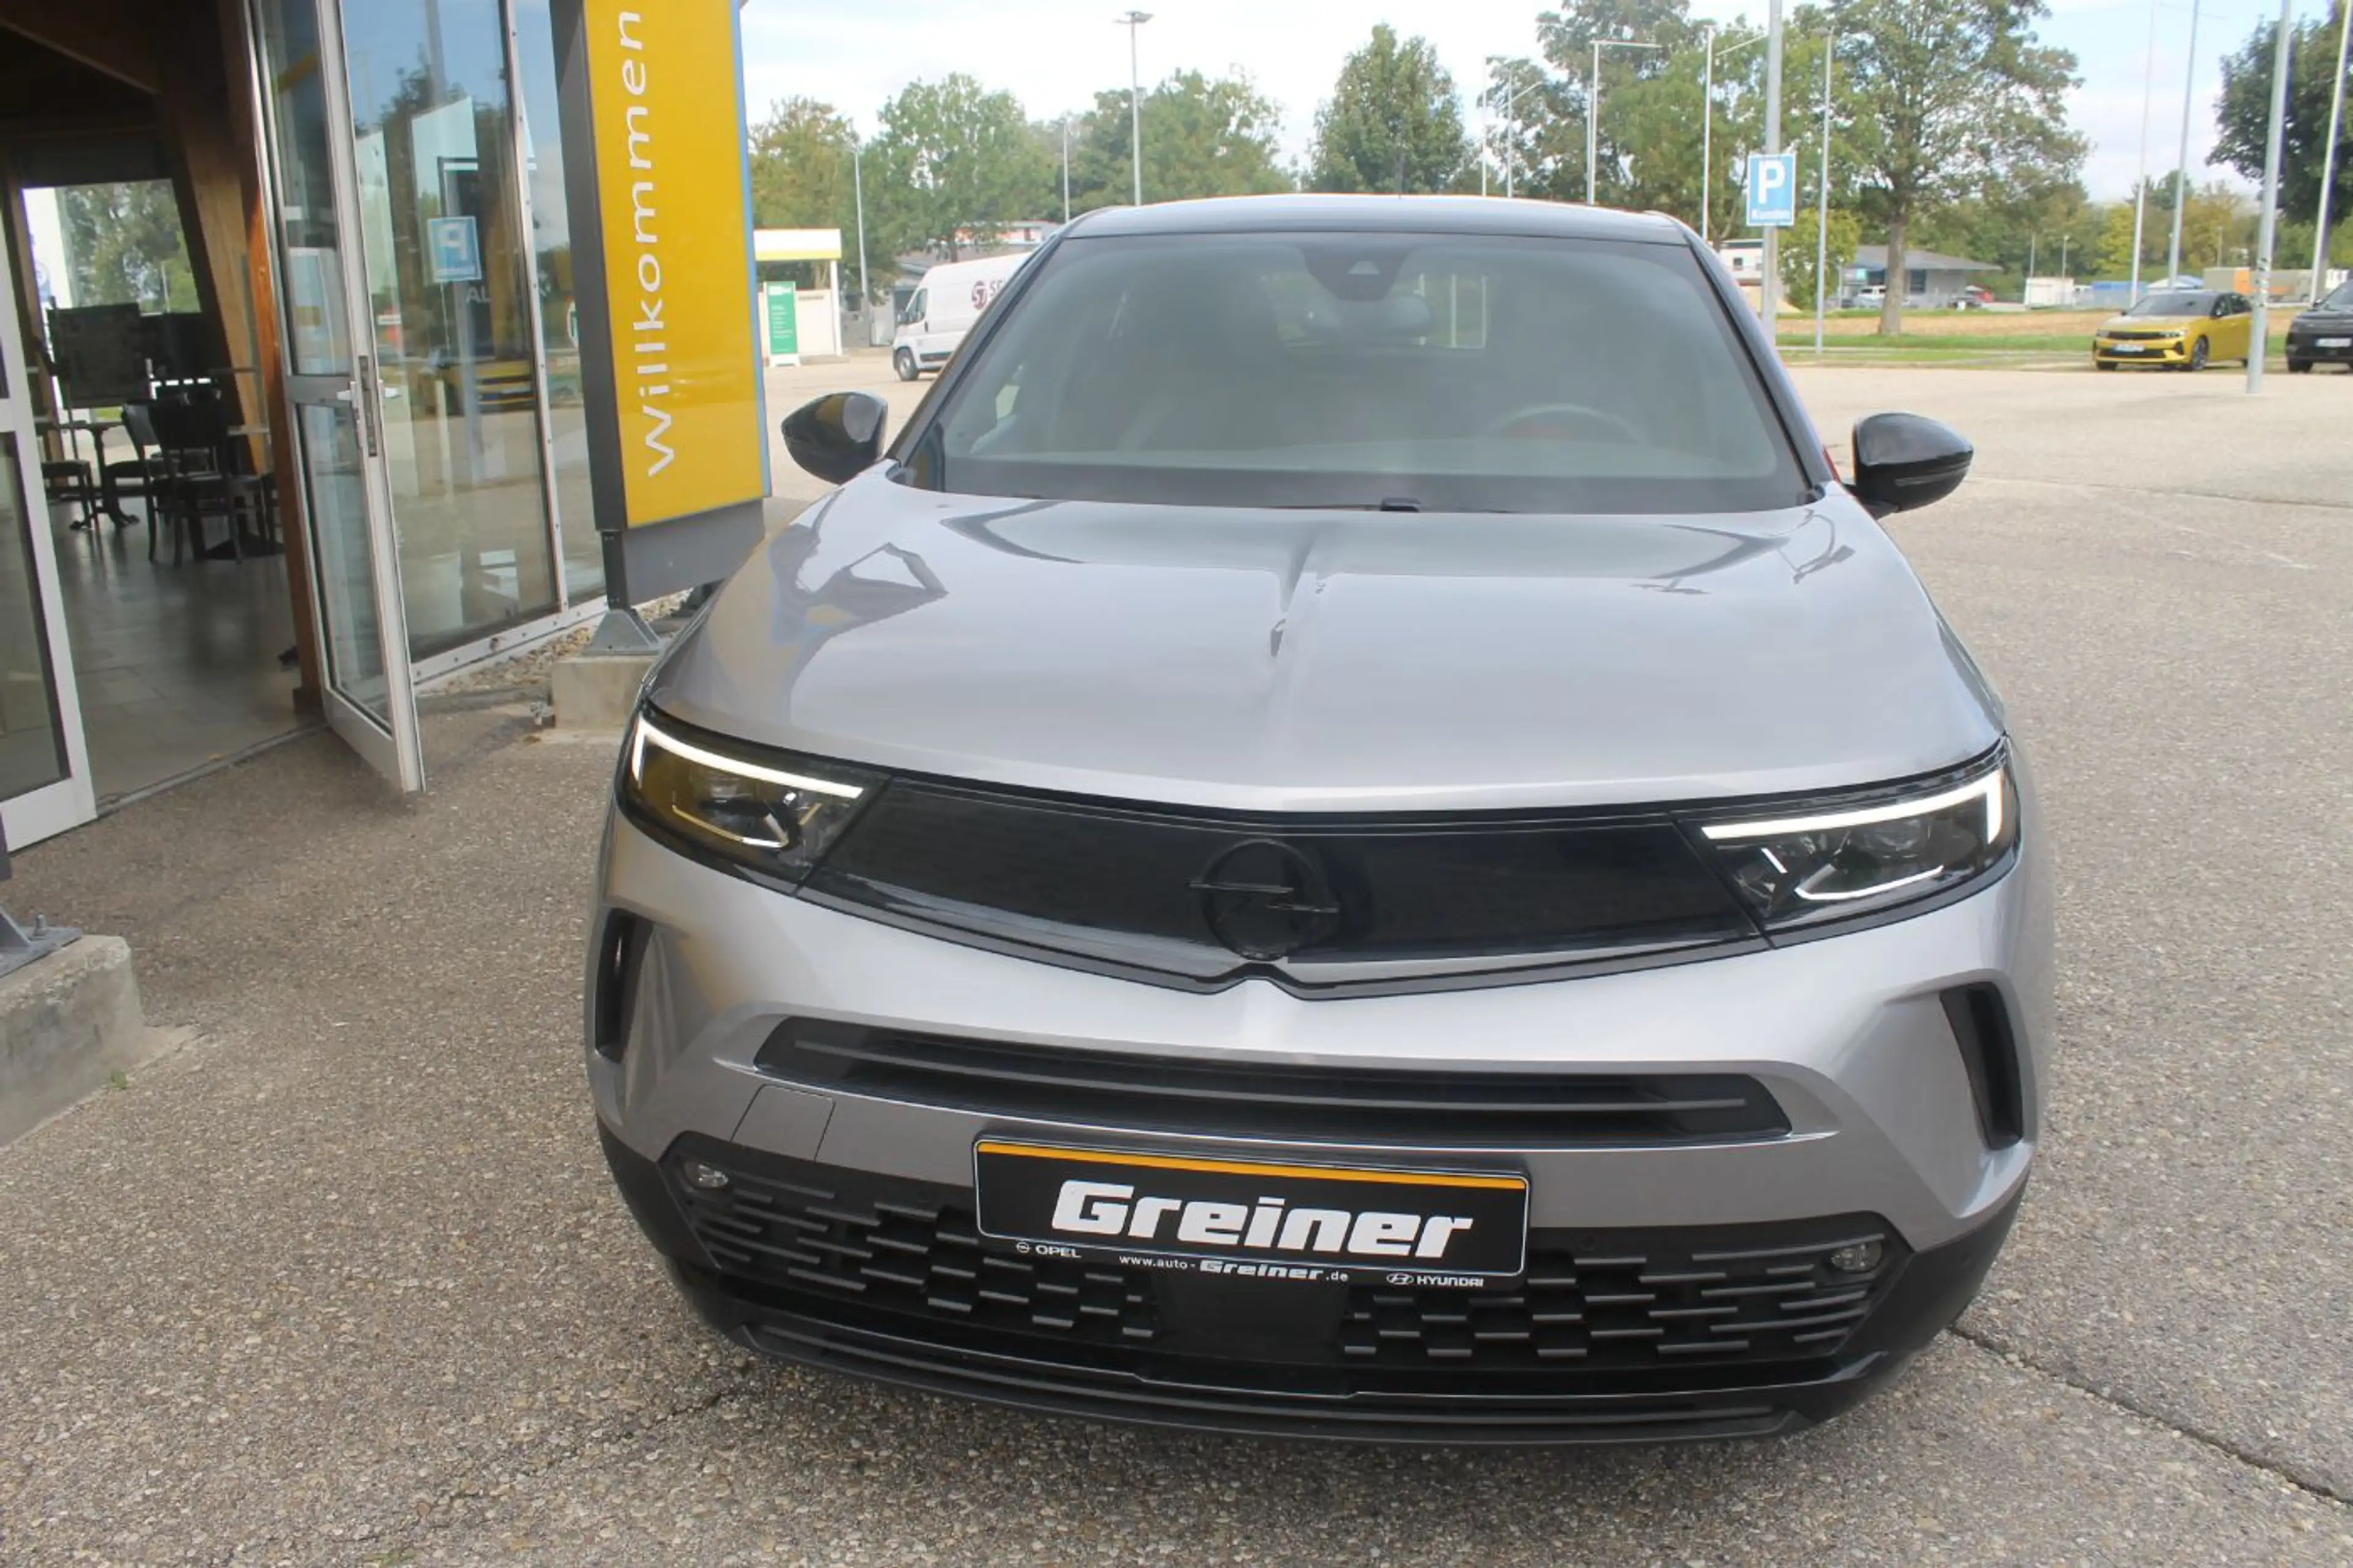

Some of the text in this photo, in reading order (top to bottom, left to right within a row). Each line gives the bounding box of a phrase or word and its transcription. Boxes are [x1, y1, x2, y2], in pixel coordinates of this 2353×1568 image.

[1757, 160, 1786, 204] P
[619, 12, 674, 477] Willkommen
[1051, 1179, 1473, 1258] Greiner
[1035, 1244, 1082, 1259] OPEL
[1417, 1275, 1483, 1287] HYUNDAI
